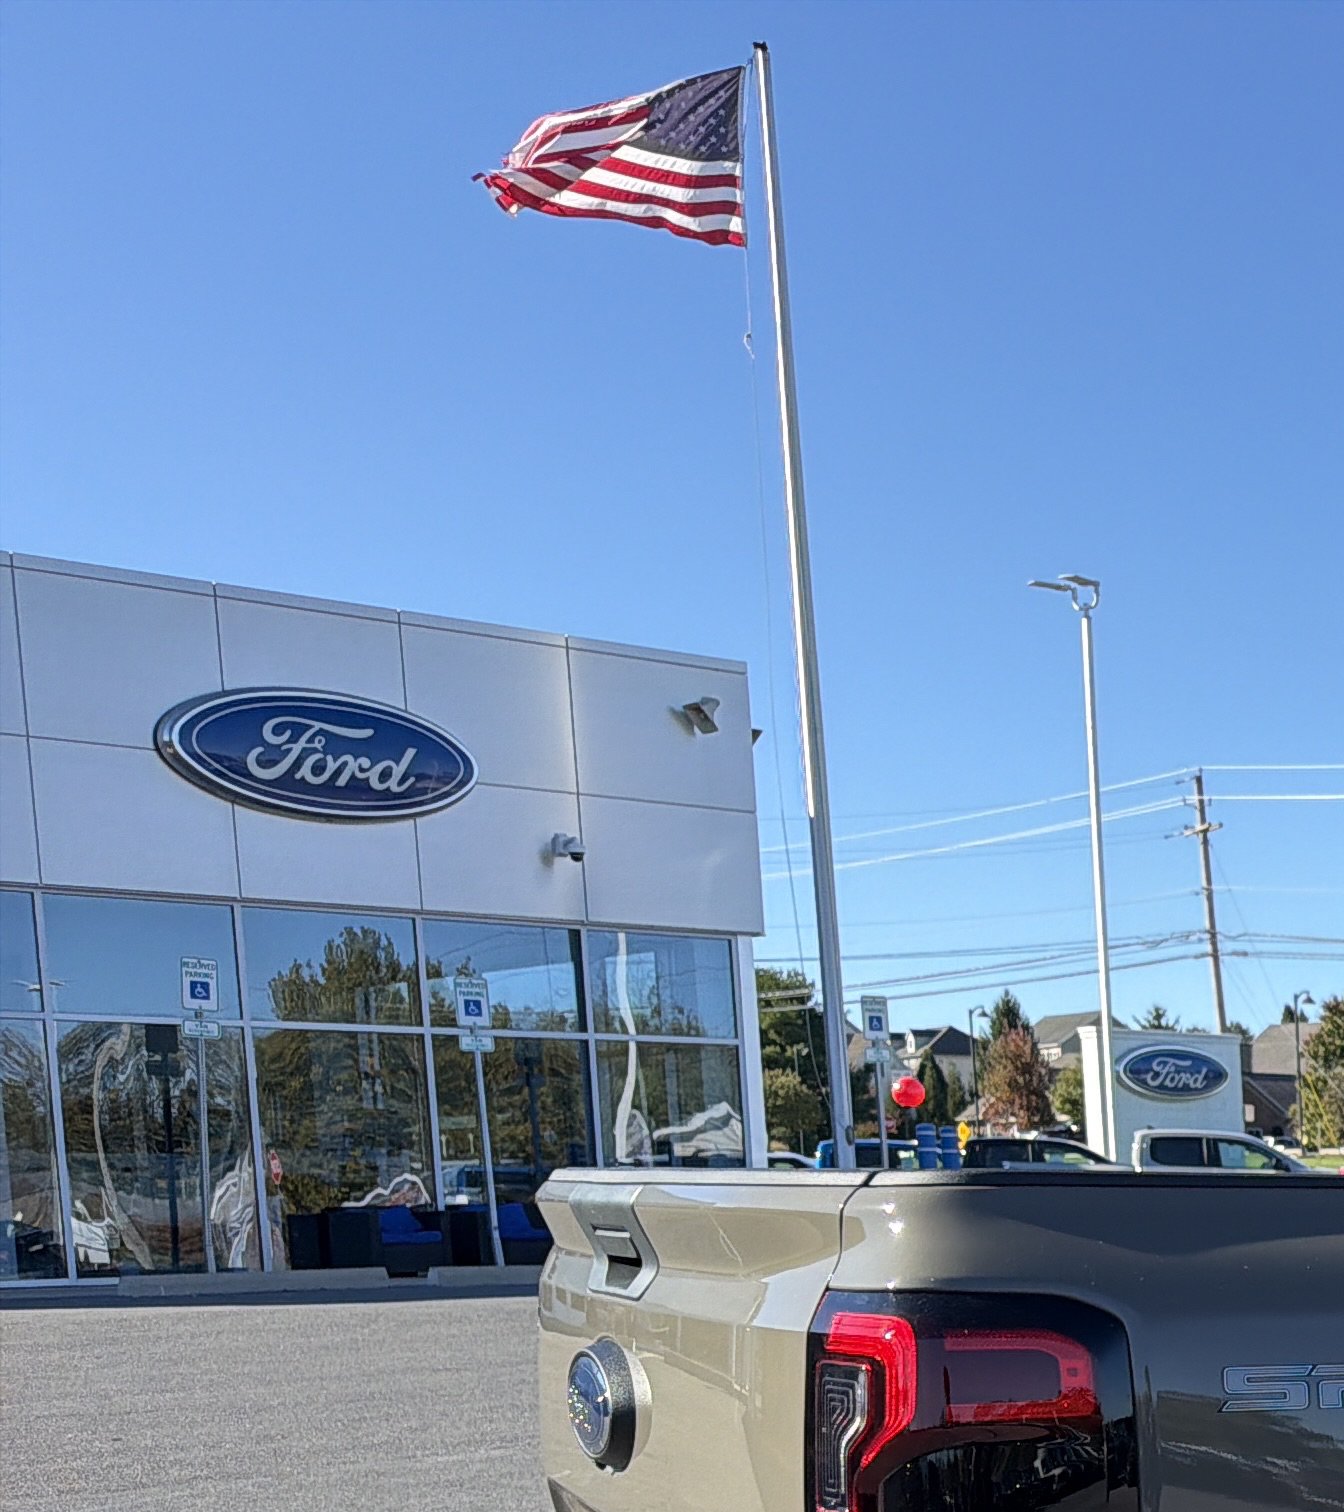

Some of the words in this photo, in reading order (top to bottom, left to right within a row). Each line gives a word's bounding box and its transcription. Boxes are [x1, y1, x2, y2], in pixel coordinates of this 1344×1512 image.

[246, 716, 418, 793] Ford
[182, 961, 216, 971] RESERVED
[184, 971, 215, 980] PARKING
[1146, 1056, 1208, 1089] Ford
